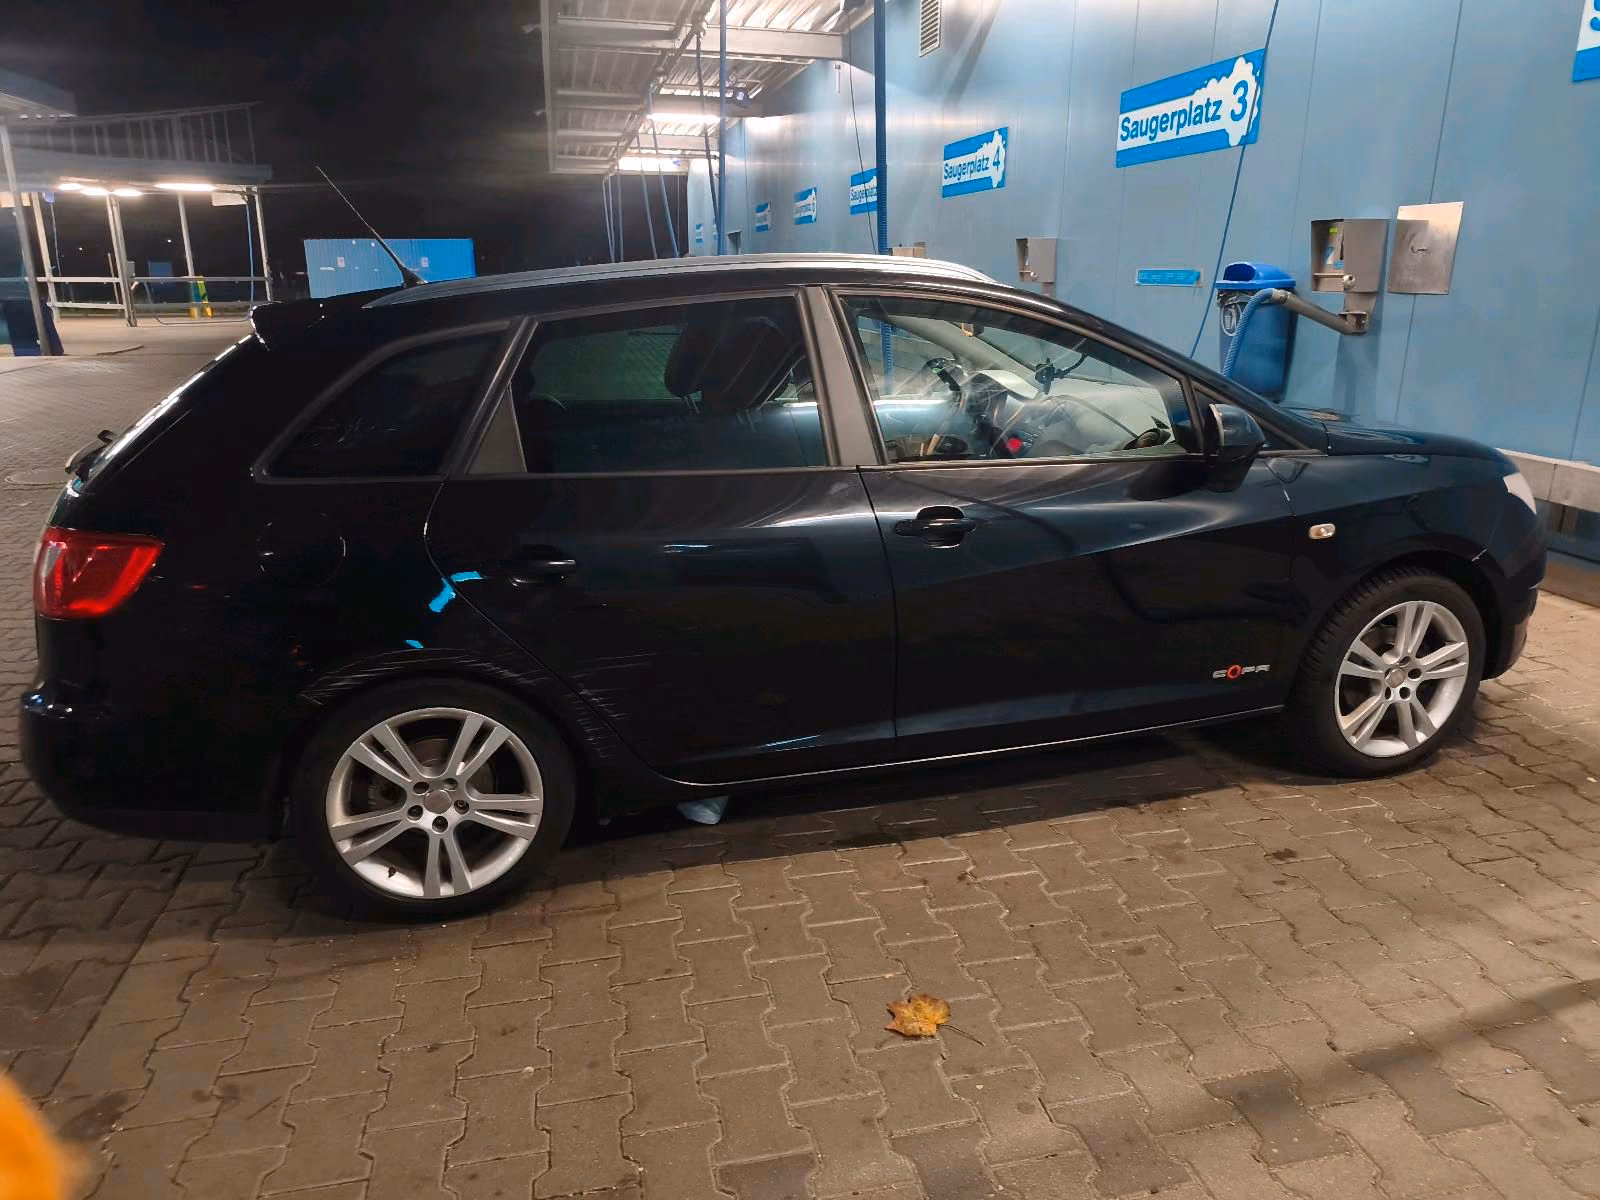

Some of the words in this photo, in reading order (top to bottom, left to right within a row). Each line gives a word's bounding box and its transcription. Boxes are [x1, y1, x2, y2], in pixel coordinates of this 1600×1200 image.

[1120, 97, 1223, 142] Saugerplatz
[1230, 79, 1249, 122] 3
[944, 155, 990, 181] Saugerplatz
[992, 145, 1001, 172] 4
